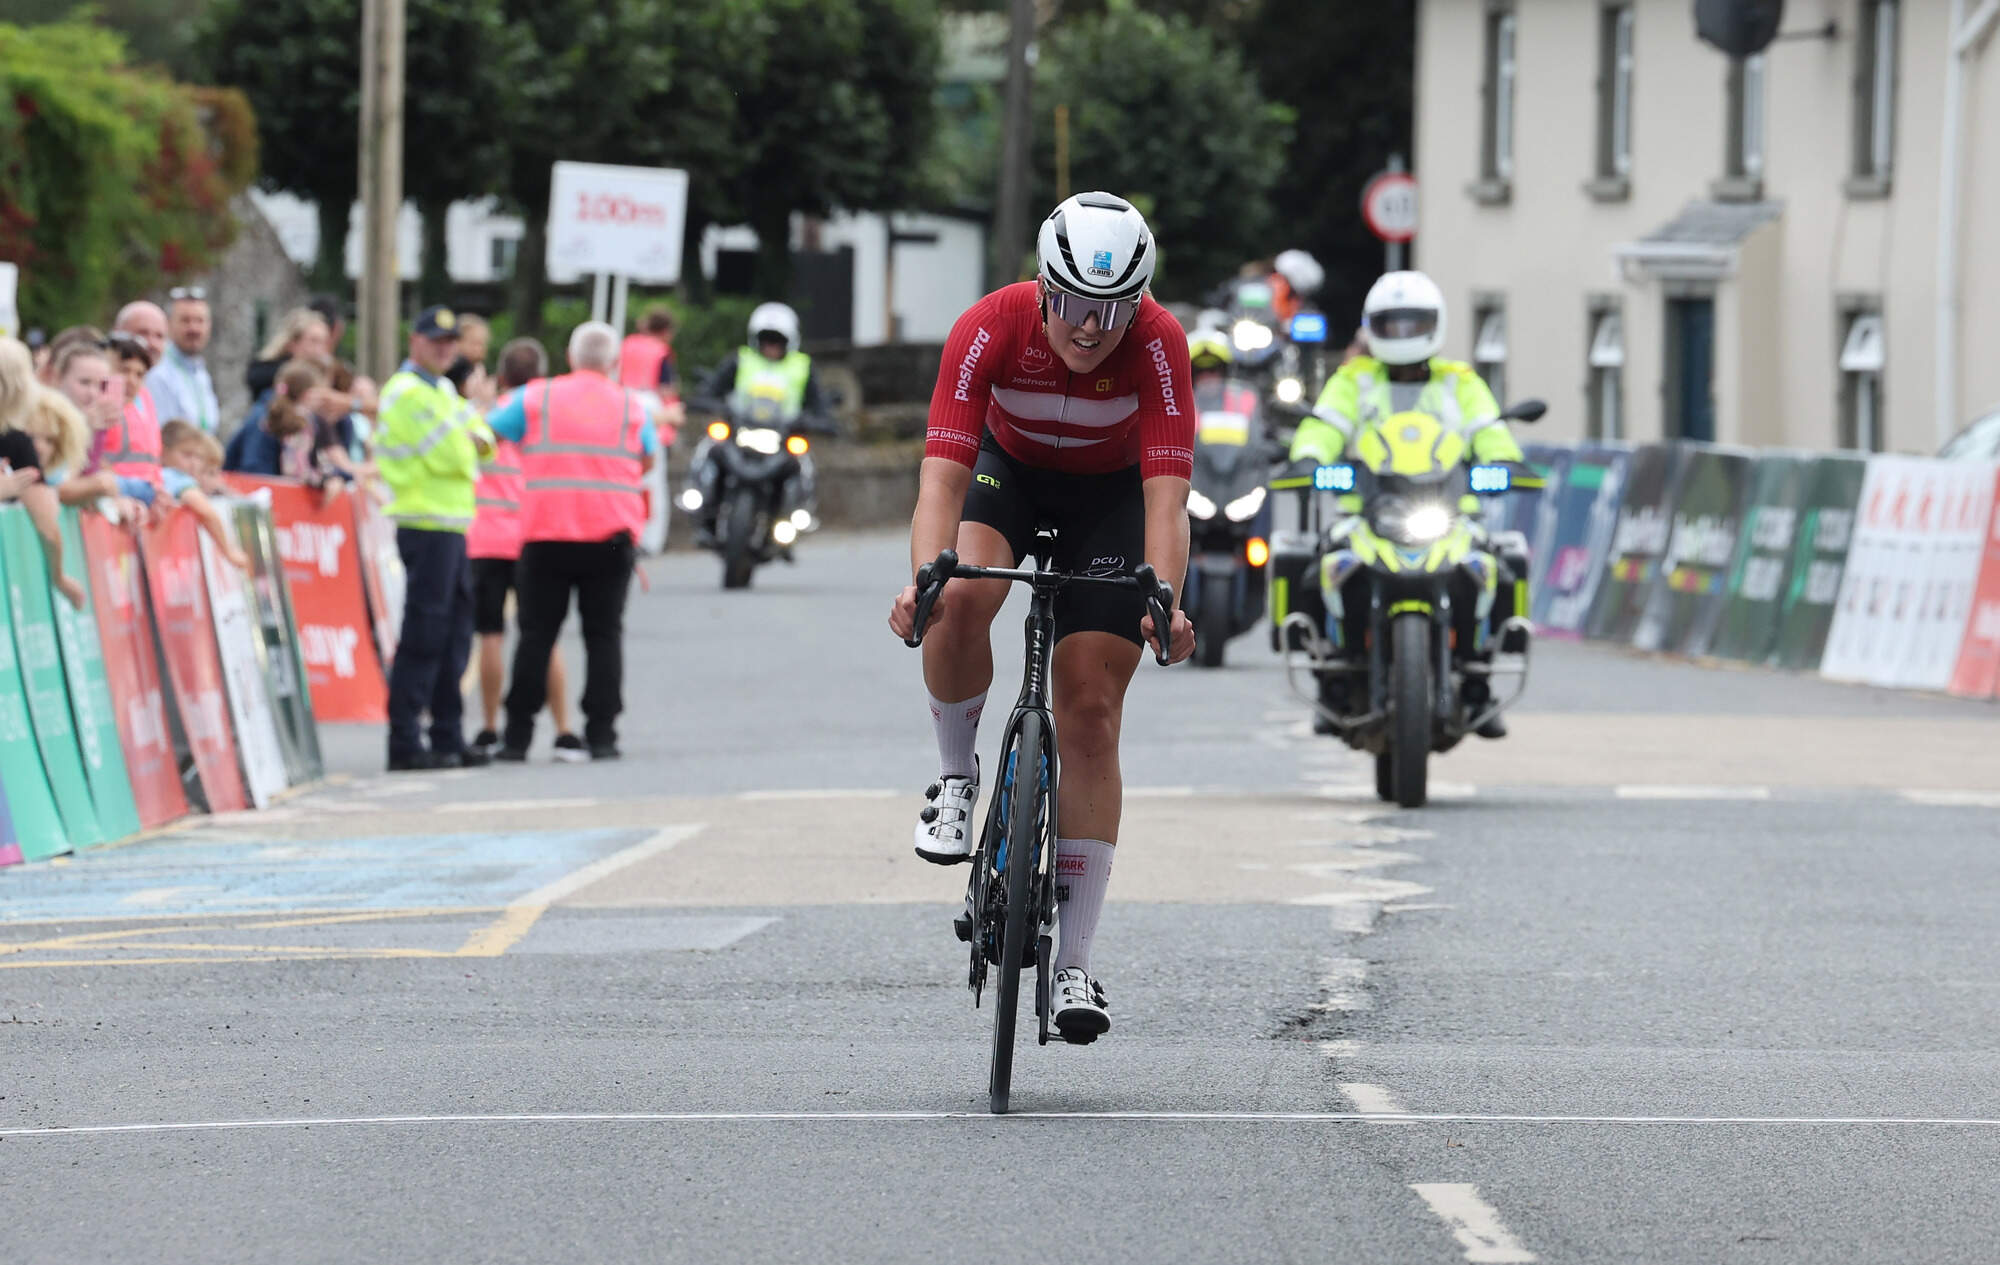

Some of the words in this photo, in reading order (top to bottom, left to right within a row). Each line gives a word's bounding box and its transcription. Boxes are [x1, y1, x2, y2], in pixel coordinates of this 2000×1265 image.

[577, 191, 666, 230] 100m
[954, 326, 991, 402] postnord
[1024, 346, 1047, 360] DCU
[1145, 337, 1181, 416] postnord
[1147, 449, 1170, 457] TEAM
[1091, 556, 1119, 566] DCU
[1030, 629, 1045, 693] FACTOR
[1056, 859, 1086, 871] MARK
